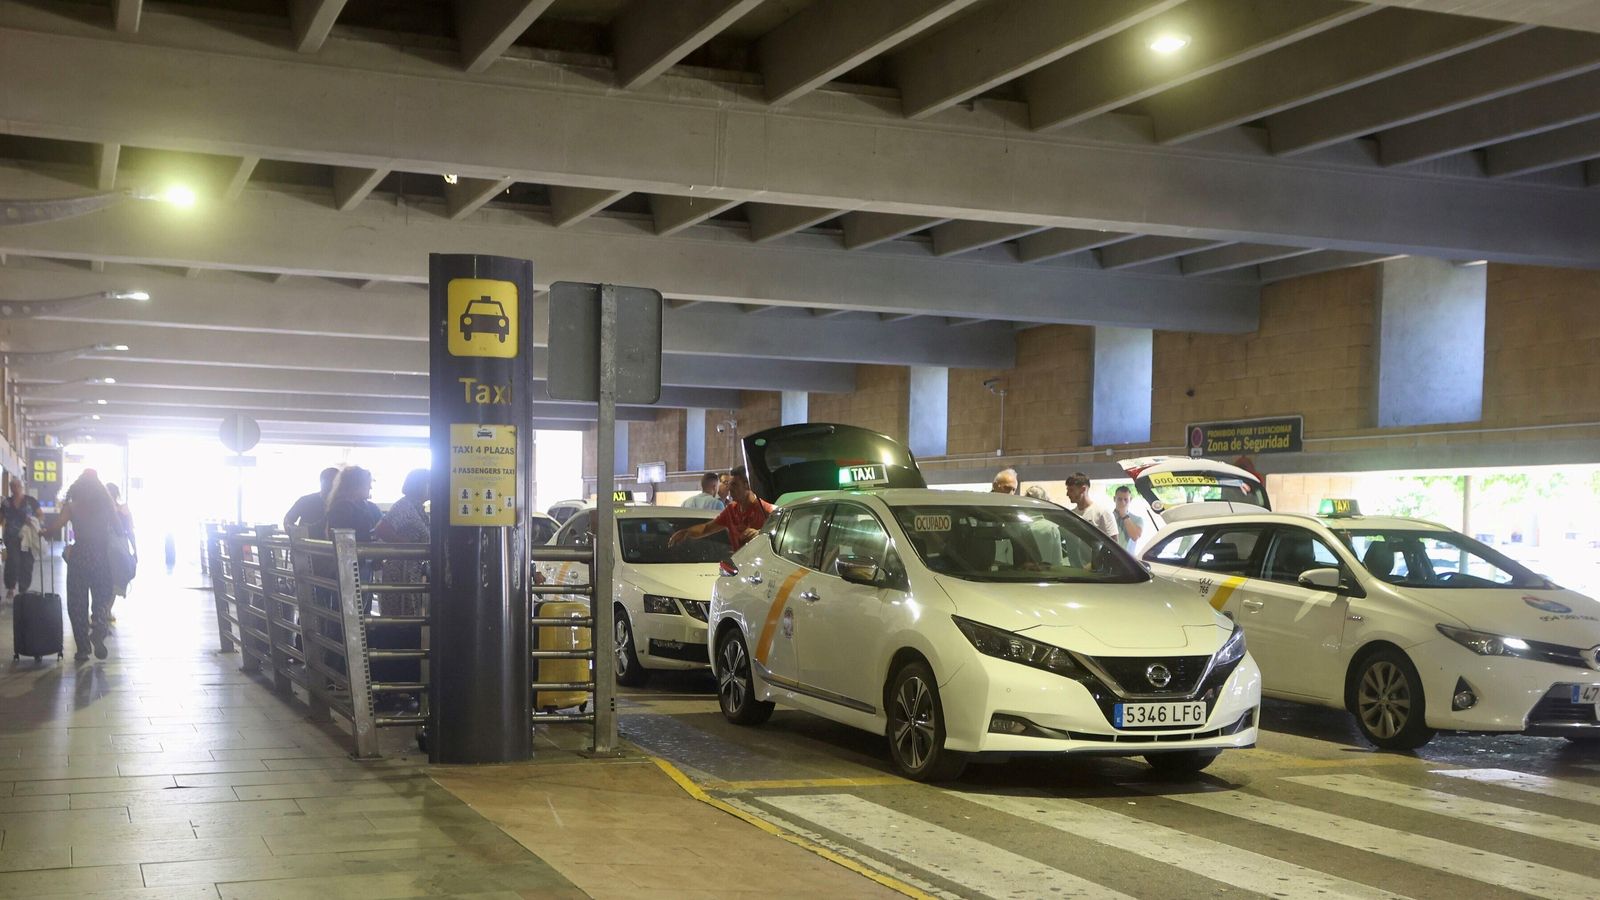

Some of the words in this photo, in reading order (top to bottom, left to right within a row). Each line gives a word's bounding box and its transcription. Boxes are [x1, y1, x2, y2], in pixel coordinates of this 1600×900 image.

[459, 377, 512, 405] Taxi
[484, 446, 515, 455] PLAZAS
[1207, 439, 1228, 452] Zona
[1231, 438, 1241, 450] de
[1244, 435, 1290, 452] Seguridad
[851, 467, 876, 481] TAXI
[612, 491, 626, 502] AXI
[916, 517, 950, 530] OCUPADO
[1126, 705, 1167, 724] 5346
[1173, 704, 1201, 722] LFG
